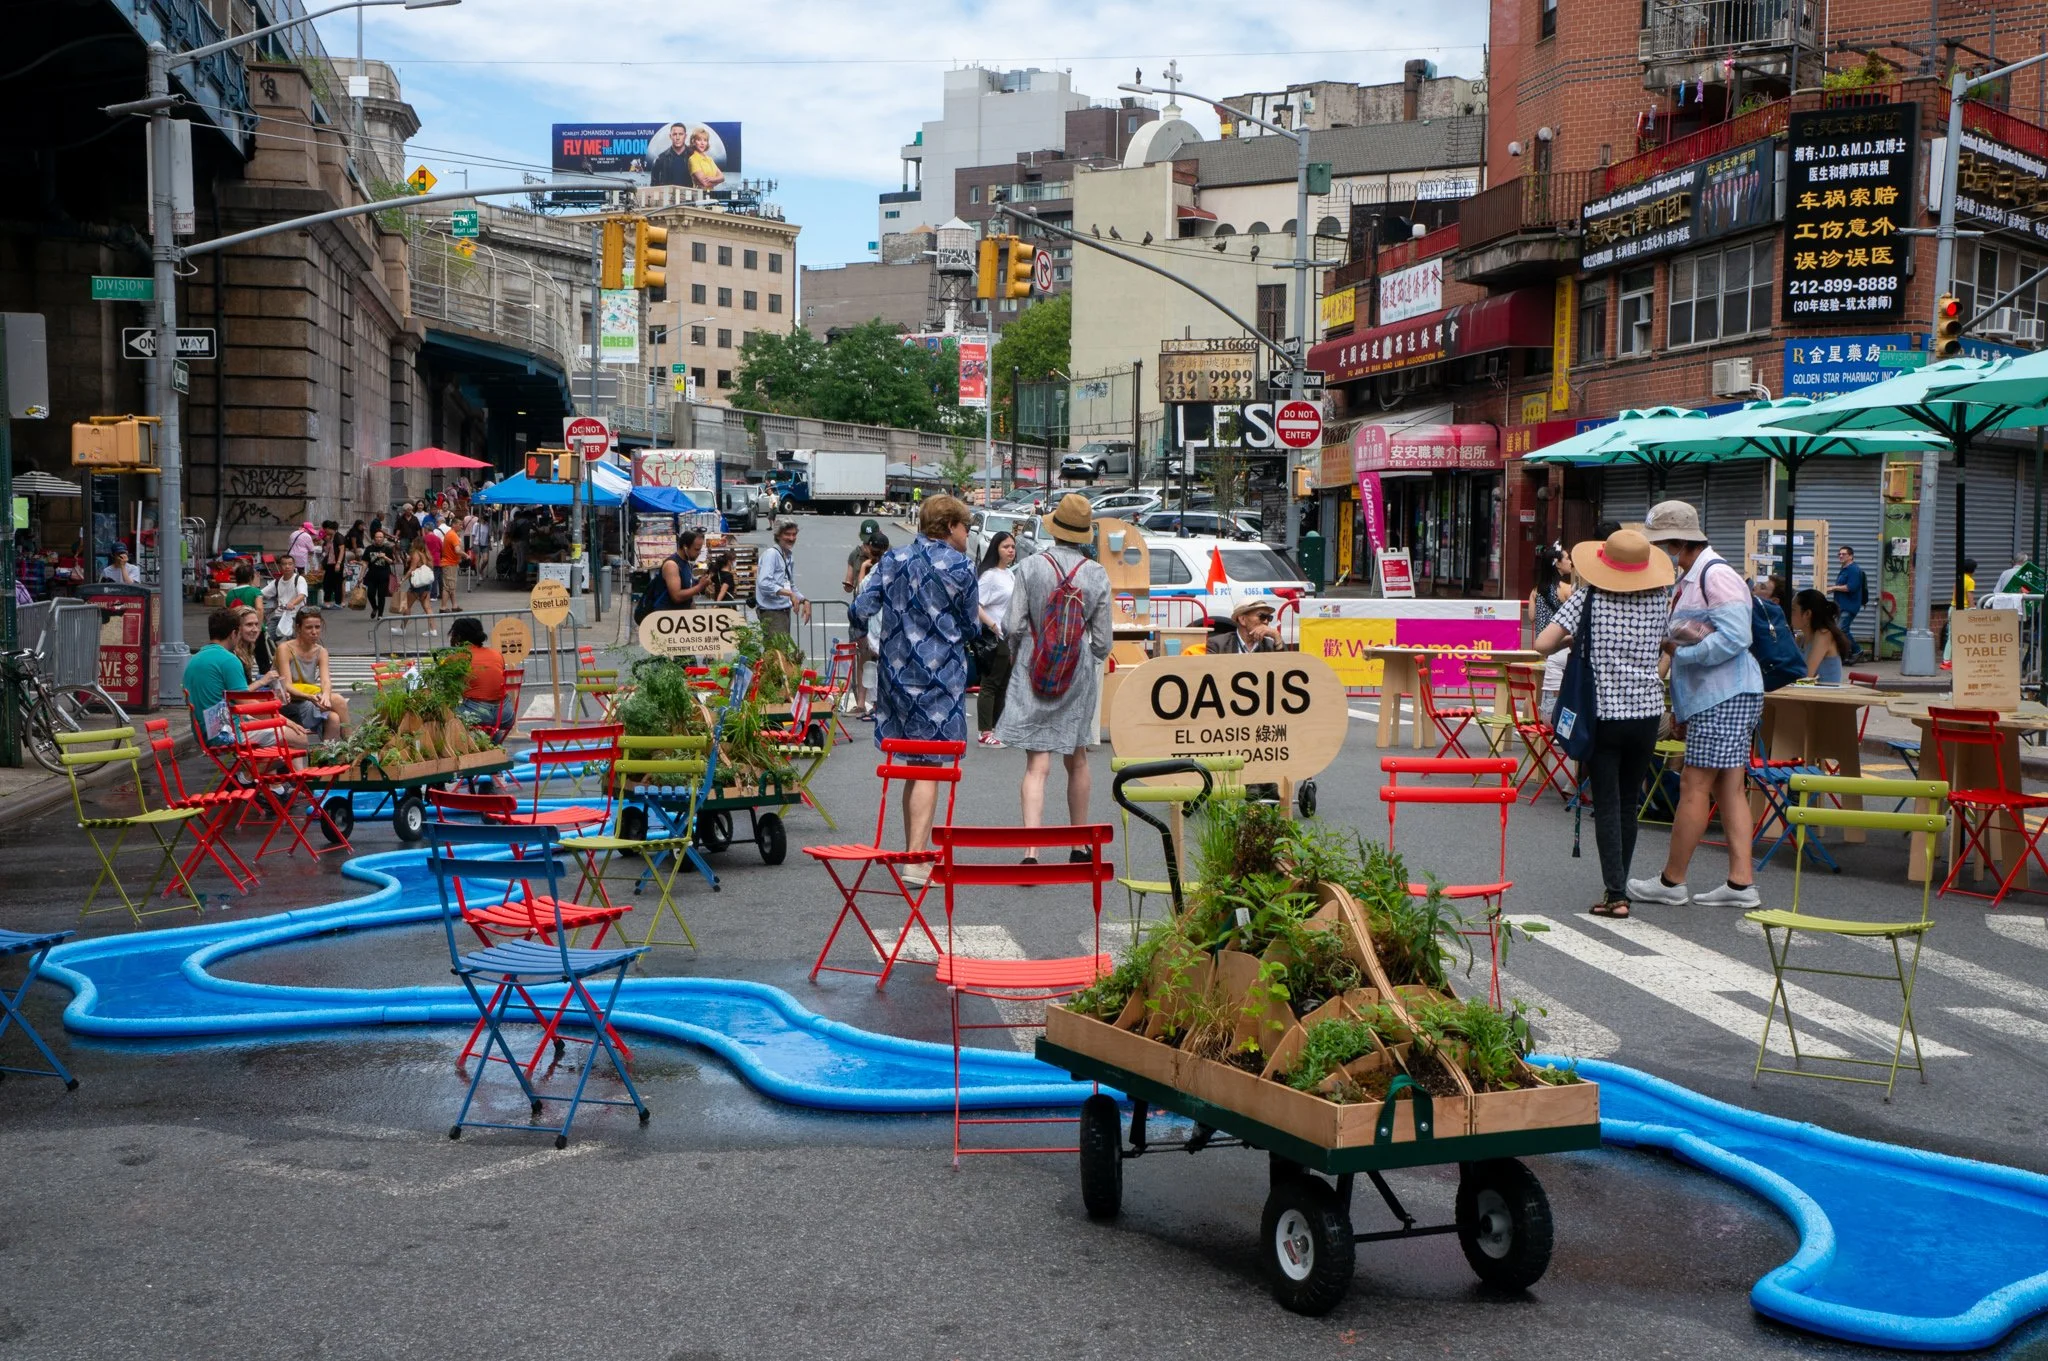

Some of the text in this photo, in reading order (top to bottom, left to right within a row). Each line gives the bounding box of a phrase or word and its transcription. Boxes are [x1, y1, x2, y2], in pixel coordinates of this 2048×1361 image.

[563, 139, 602, 155] FLY ME
[602, 147, 613, 155] THE
[613, 139, 649, 155] MOON
[1808, 159, 1890, 182] 医生和律师双执照
[1796, 186, 1899, 210] 车祸索赔
[1793, 216, 1896, 240] 工伤意外
[1793, 246, 1894, 270] 误诊误医
[95, 279, 145, 291] DIVISION
[1789, 276, 1898, 295] 212-899-8888
[139, 338, 205, 349] ON WAY
[602, 335, 634, 348] GREEN
[1228, 338, 1258, 351] 6666
[1407, 353, 1436, 365] ASSOCIATION
[1164, 370, 1253, 385] 219 9999
[1792, 373, 1820, 385] GOLDEN
[1822, 372, 1840, 384] STAR
[1842, 371, 1880, 383] PHARMACY
[1164, 385, 1253, 400] 334 3333
[1284, 410, 1314, 418] DO NOT
[1177, 403, 1275, 448] LES
[1285, 431, 1312, 439] ENTER
[586, 445, 600, 453] TER
[1391, 445, 1487, 460] 安安職業介紹所
[532, 598, 569, 609] Street Lab
[657, 614, 730, 634] OASIS
[1957, 632, 2013, 644] ONE BIG
[692, 644, 720, 652] L'OASIS
[1964, 646, 2007, 657] TABLE
[1151, 669, 1311, 720] OASIS
[1175, 727, 1250, 744] EL OASIS
[1256, 724, 1287, 744] 綠洲
